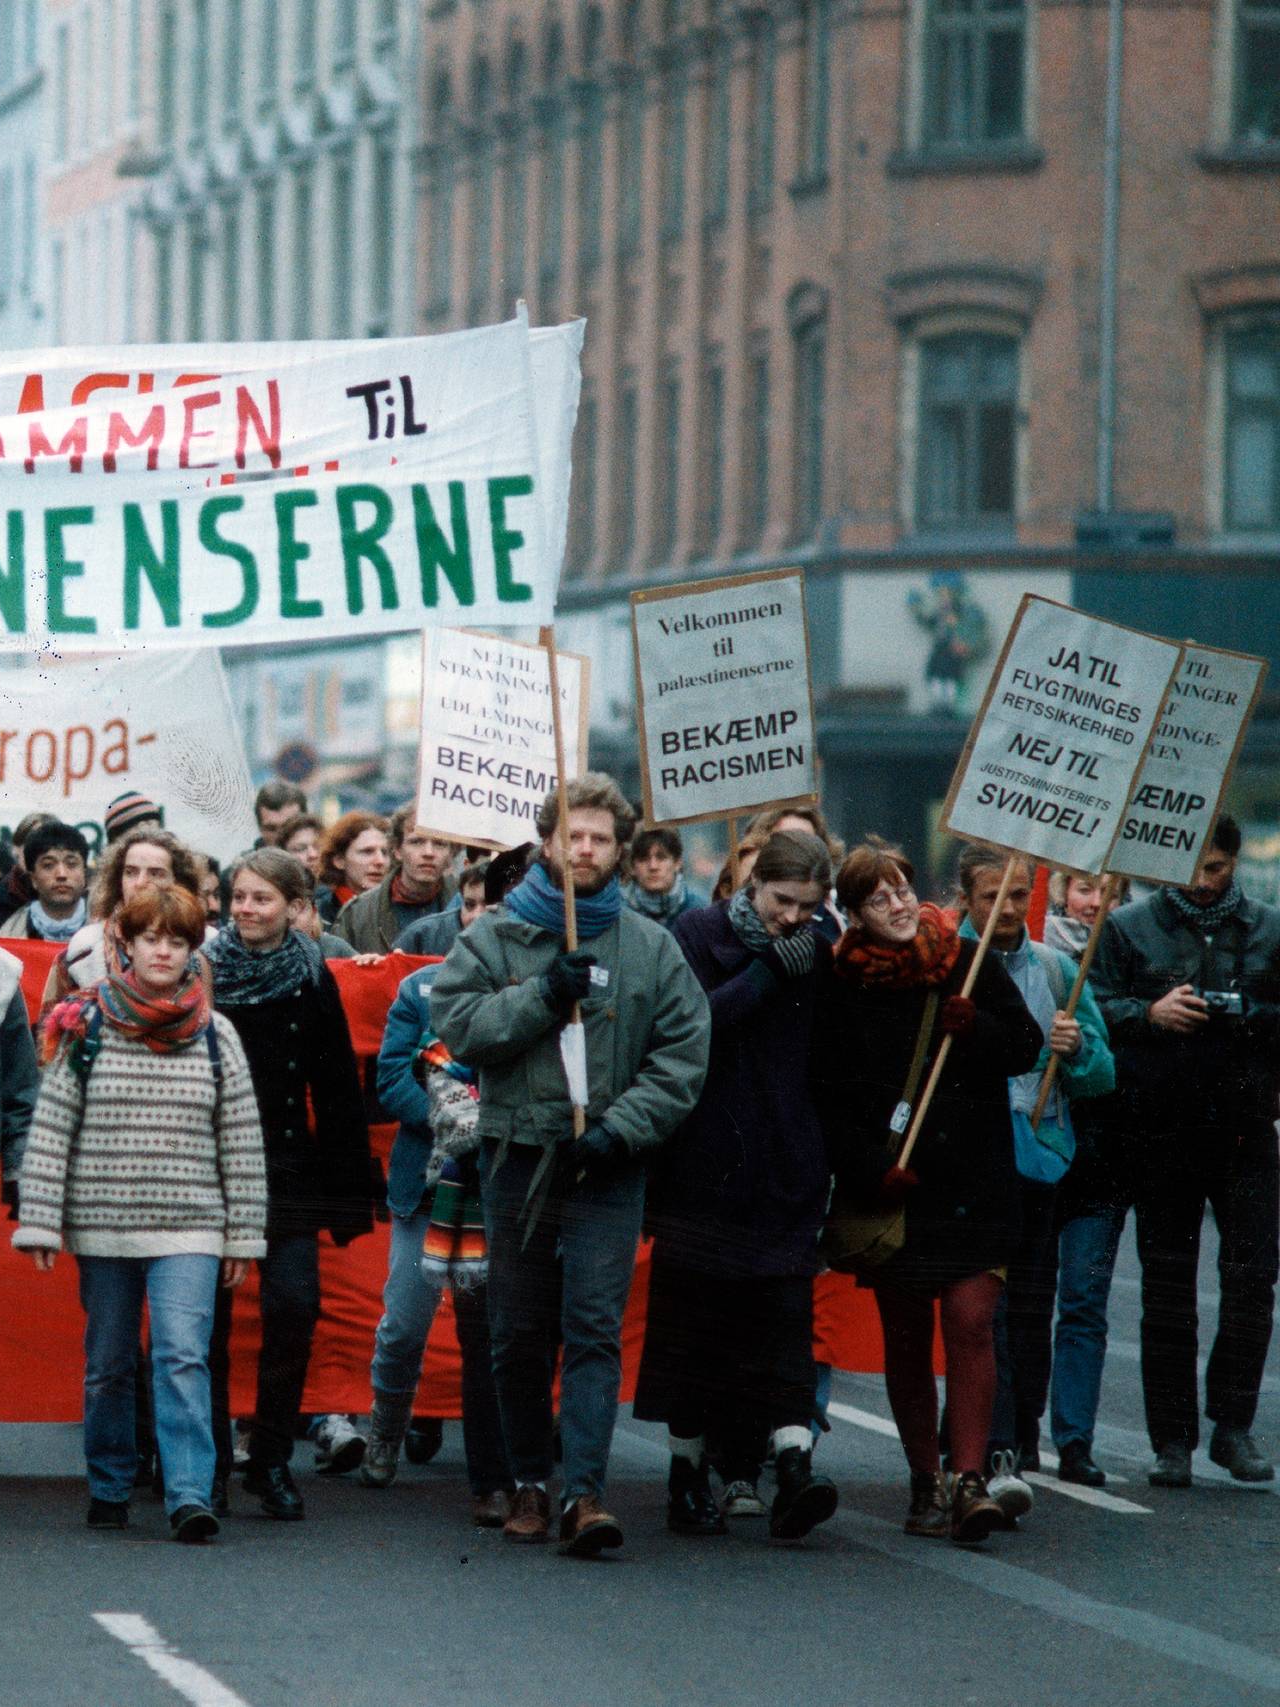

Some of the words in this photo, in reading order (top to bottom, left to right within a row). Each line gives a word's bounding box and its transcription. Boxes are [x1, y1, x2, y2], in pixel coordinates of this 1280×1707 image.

[658, 602, 783, 636] Velkommen
[713, 637, 734, 657] til
[1048, 647, 1080, 674] JA
[1088, 656, 1122, 687] TIL
[657, 659, 795, 696] palæstinenserne
[1012, 669, 1142, 723] FLYGTNINGES
[661, 710, 798, 755] BEKÆMP
[1002, 692, 1135, 745] RETSSIKKERHED
[661, 745, 805, 790] RACISMEN
[1008, 733, 1064, 766] NEJ
[1067, 750, 1099, 780] TIL
[431, 777, 544, 820] RACISME
[980, 762, 1111, 812] JUSTITSMINISTERIETS
[977, 783, 1101, 838] SVINDEL!
